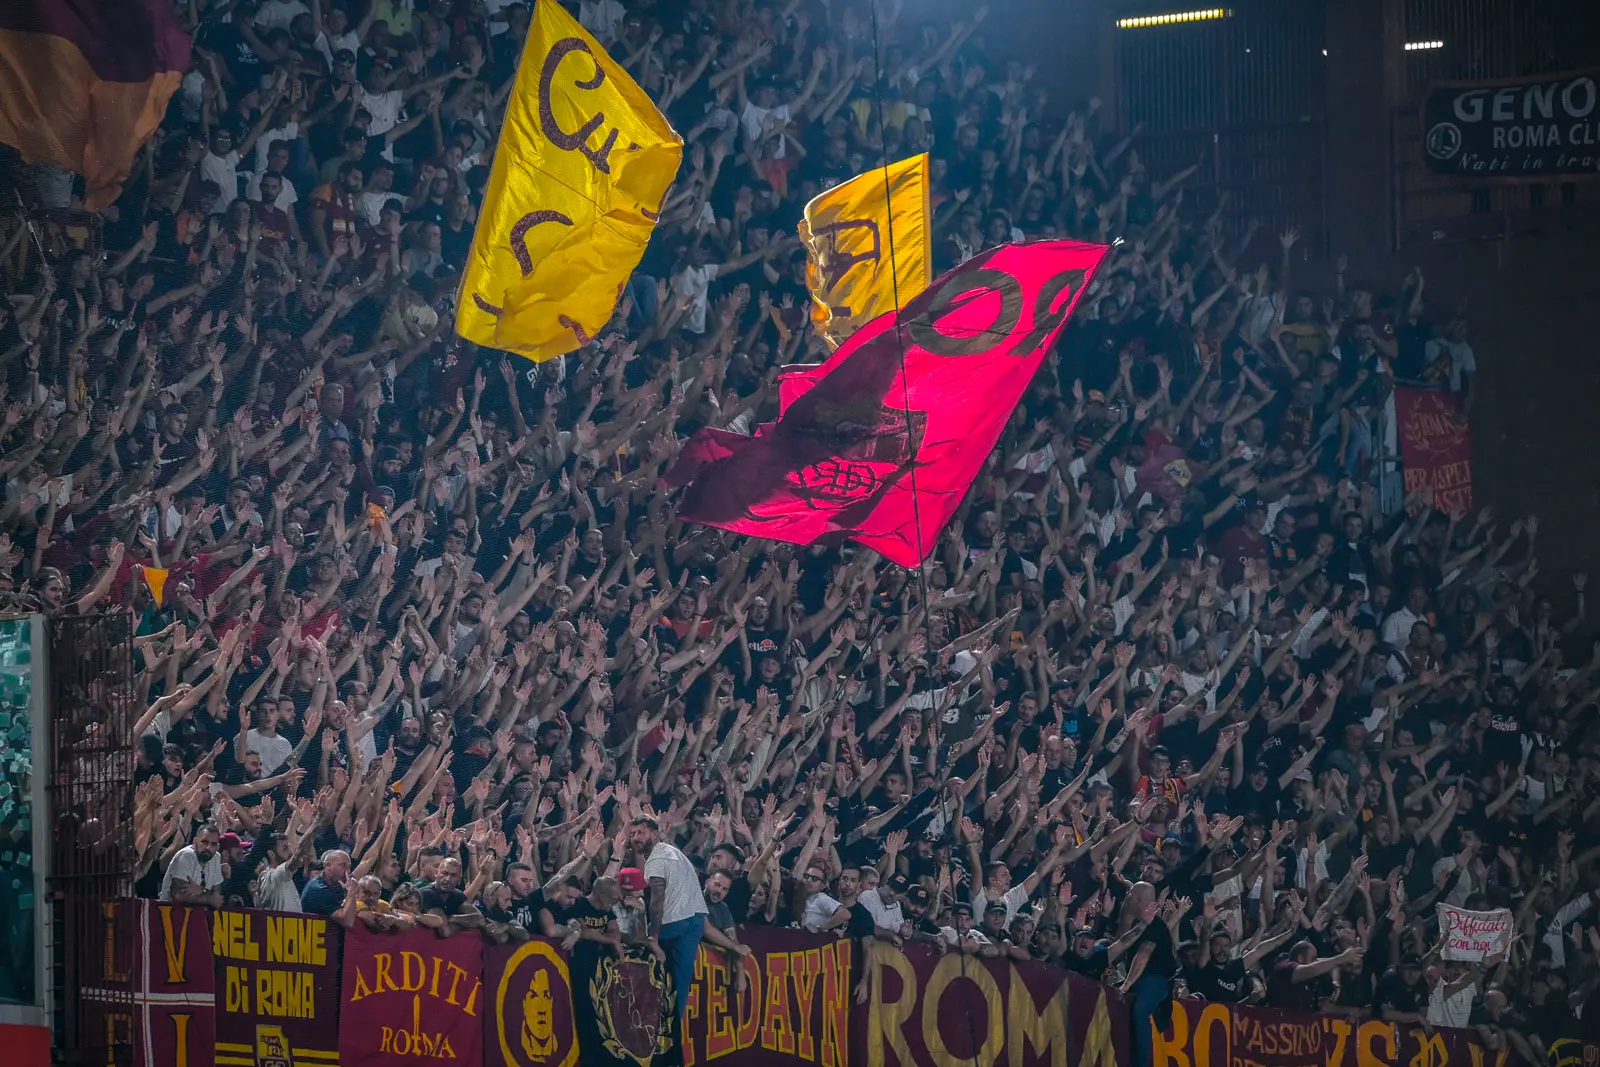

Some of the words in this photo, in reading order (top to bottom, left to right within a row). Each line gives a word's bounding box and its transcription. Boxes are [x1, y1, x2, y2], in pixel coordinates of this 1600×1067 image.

[1493, 124, 1561, 149] ROMA
[1568, 121, 1600, 146] CL
[213, 911, 259, 961] NEL
[266, 916, 327, 966] NOME
[1448, 938, 1470, 951] con
[1473, 936, 1491, 952] noi
[226, 966, 249, 1014] Di
[256, 969, 315, 1019] ROMA
[350, 951, 482, 1017] ARDITI
[681, 938, 851, 1067] FEDAYN
[867, 940, 1116, 1067] ROMA
[380, 1026, 456, 1058] ROMA
[1233, 1010, 1321, 1056] MASSIMO
